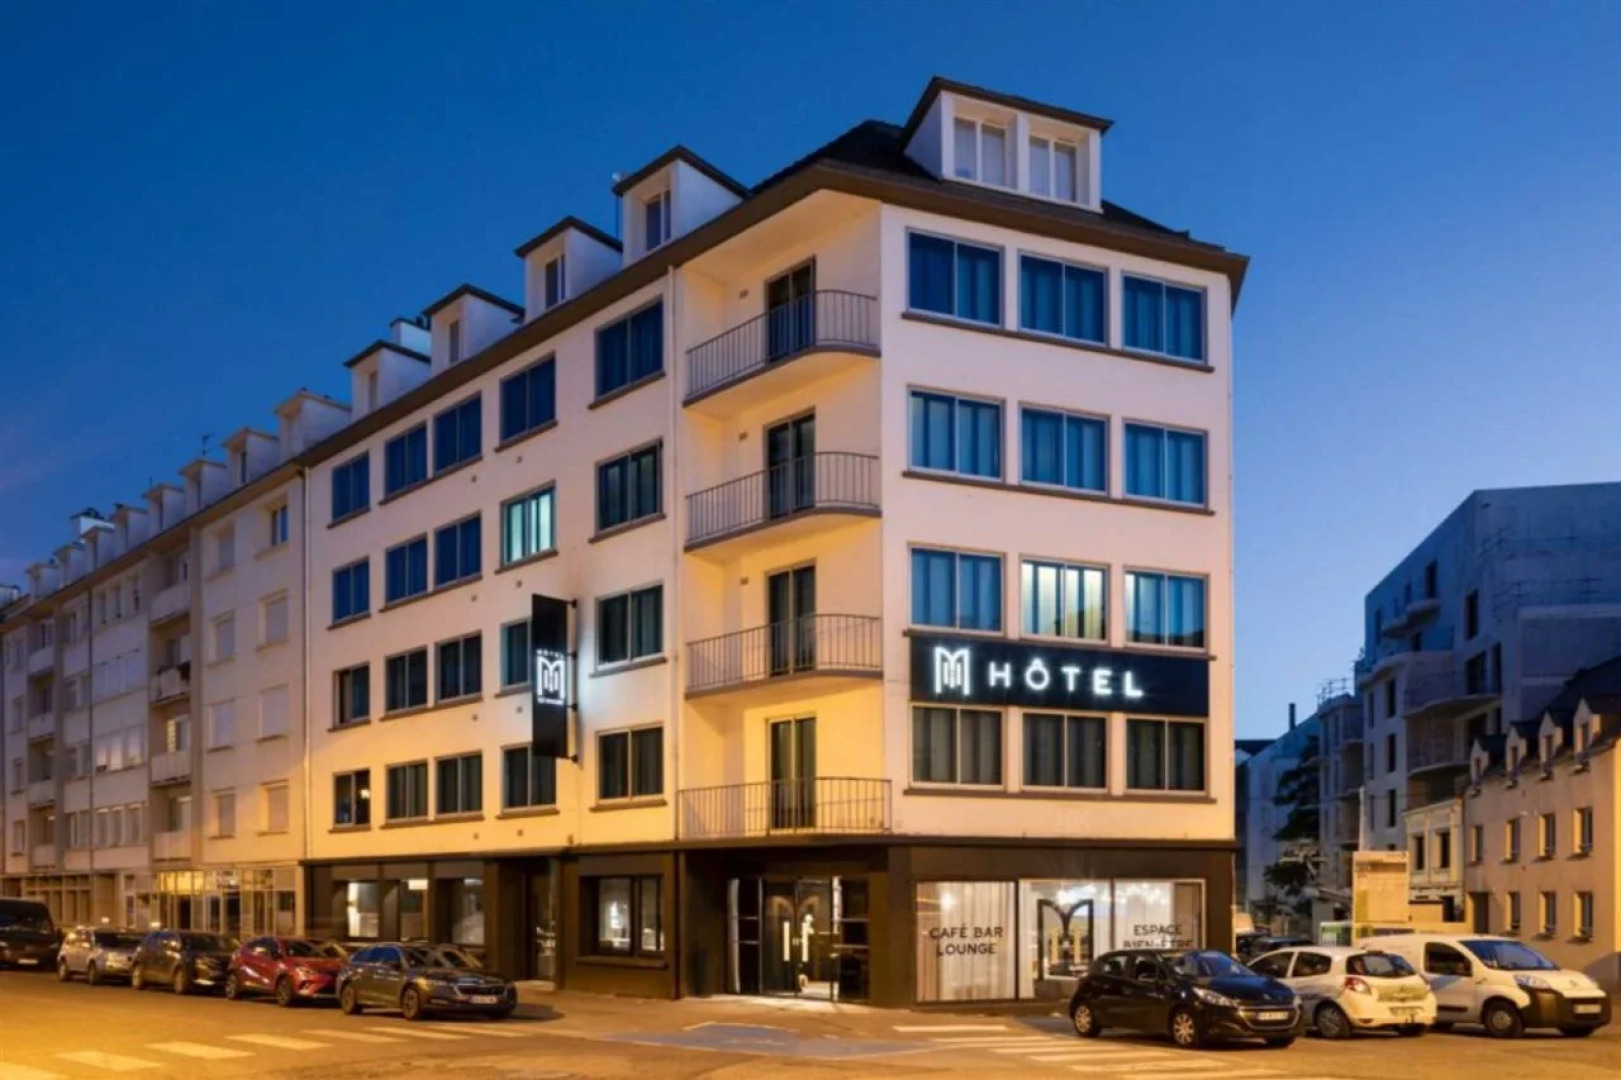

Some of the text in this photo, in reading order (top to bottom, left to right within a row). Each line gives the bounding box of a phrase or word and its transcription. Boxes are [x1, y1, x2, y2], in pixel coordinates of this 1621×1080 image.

[988, 657, 1144, 697] HÔTEL
[929, 922, 1004, 939] CAFÉ BAR
[1133, 923, 1183, 937] ESPACE
[935, 942, 997, 957] LOUNGE
